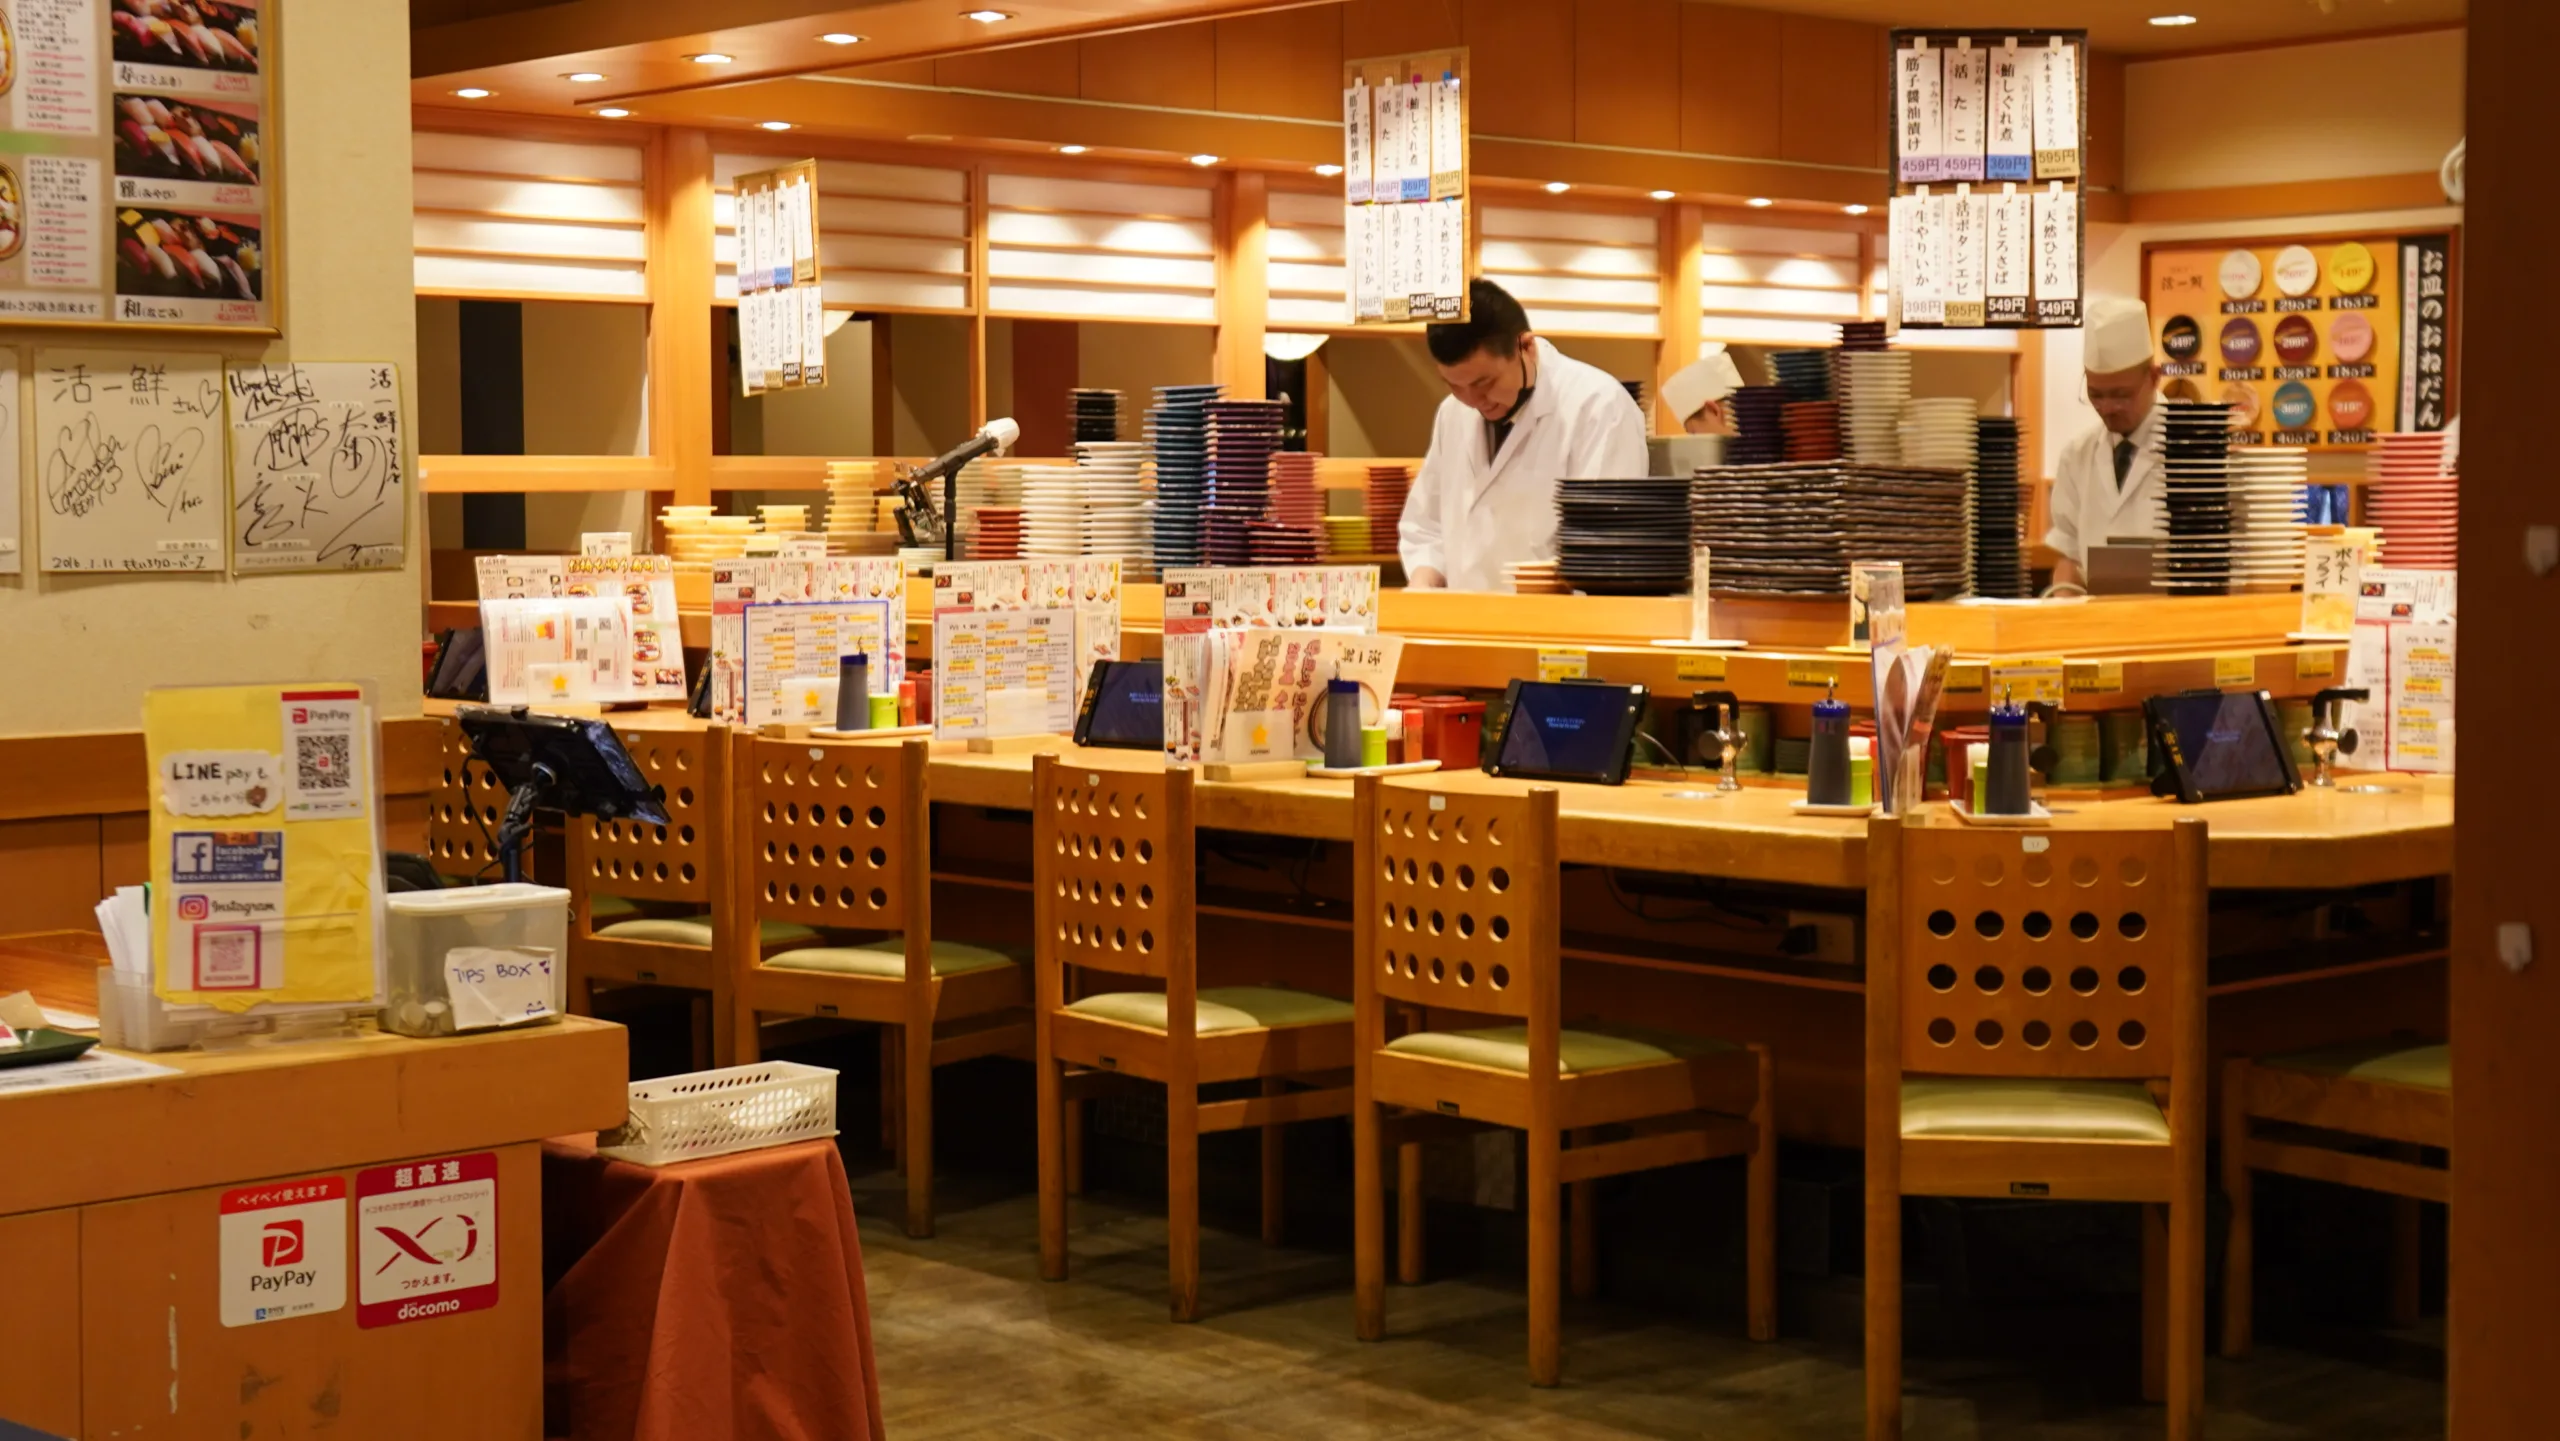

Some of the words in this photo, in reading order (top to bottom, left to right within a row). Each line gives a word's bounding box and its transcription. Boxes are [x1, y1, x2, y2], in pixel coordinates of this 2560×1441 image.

[1906, 57, 1921, 151] 筋子醤油漬け
[1954, 63, 1968, 143] 活たこ
[2000, 62, 2015, 143] 鮪しぐれ煮
[1382, 100, 1391, 168] 活たこ
[1902, 157, 1940, 172] 459円
[1944, 157, 1981, 171] 459円
[1990, 158, 2027, 171] 369円
[2038, 149, 2076, 163] 595円
[1915, 209, 1929, 287] 生やりいか
[1956, 202, 1970, 296] 活ボタンエビ
[1995, 208, 2009, 285] 生とろさば
[2043, 210, 2058, 285] 天然ひらめ
[1905, 300, 1942, 314] 398円
[1945, 303, 1981, 318] 595円
[1988, 299, 2026, 313] 549円
[2038, 301, 2075, 315] 549円
[2419, 250, 2445, 428] お皿のおねだん
[52, 363, 169, 405] 活一鮮
[2315, 554, 2331, 588] フライ
[2335, 547, 2352, 585] ポテト
[309, 707, 351, 723] PayPay
[172, 763, 222, 781] LINE
[211, 901, 276, 917] Instagram
[453, 968, 485, 983] TIPS
[497, 963, 533, 978] BOX
[395, 1161, 461, 1188] 超高速
[237, 1184, 329, 1206] ペイペイ使えます
[250, 1269, 317, 1292] PayPay
[401, 1273, 456, 1290] つかえます。
[398, 1299, 460, 1320] docomo
